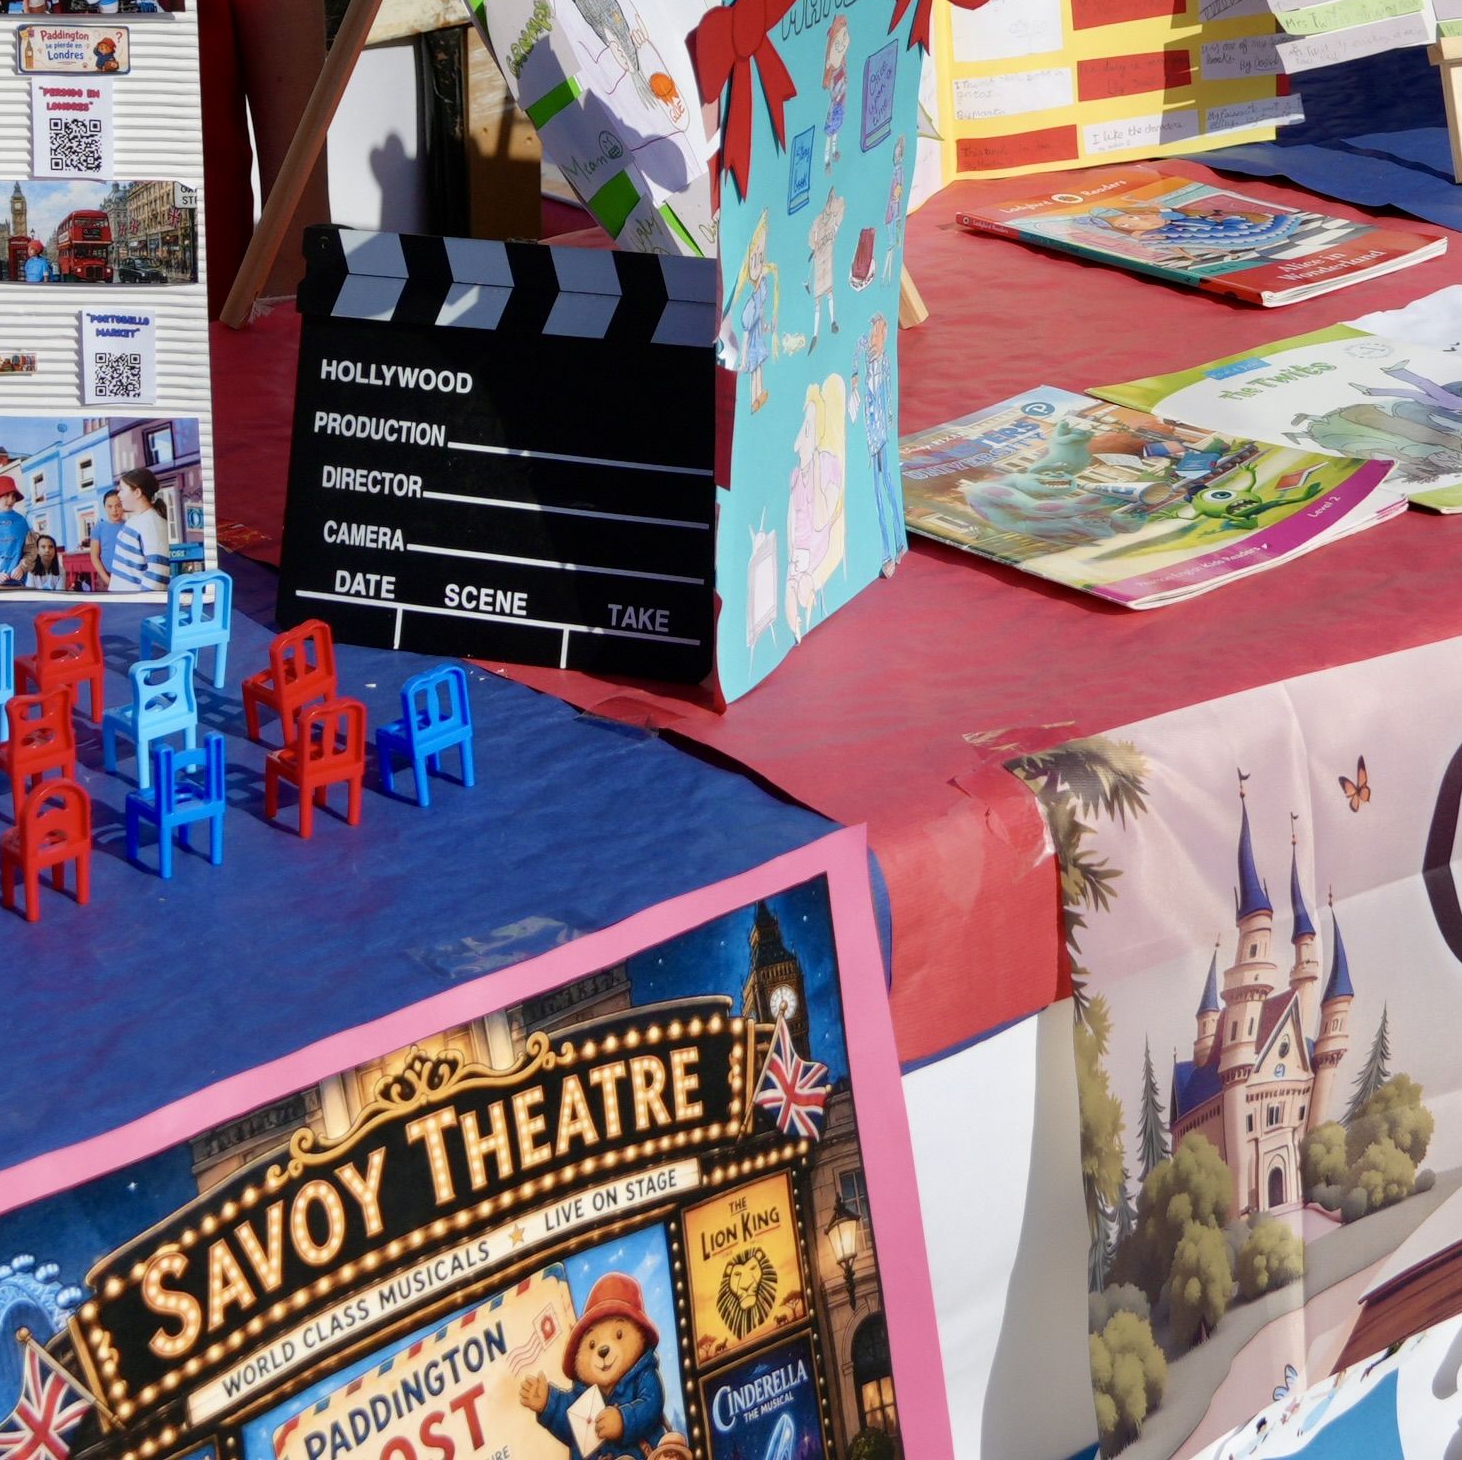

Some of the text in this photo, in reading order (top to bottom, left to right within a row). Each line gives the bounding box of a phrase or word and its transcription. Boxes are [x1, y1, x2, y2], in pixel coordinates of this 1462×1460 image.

[40, 29, 89, 43] Paddington
[53, 42, 73, 51] pierde
[47, 50, 85, 61] Londres
[1080, 178, 1127, 196] Readers
[1277, 249, 1347, 275] Alice in
[1277, 248, 1387, 283] Wonderland
[320, 357, 474, 395] HOLLYWOOD
[313, 411, 447, 448] PRODUCTION
[321, 464, 424, 500] DIRECTOR
[1306, 501, 1332, 519] Level
[322, 519, 406, 552] CAMERA
[334, 570, 671, 634] DATE SCENE TAKE
[138, 1045, 706, 1363] SAVOY THEATRE
[544, 1167, 679, 1232] LIVE ON STAGE
[728, 1196, 749, 1215] THE
[700, 1206, 782, 1259] LION KING
[221, 1240, 492, 1397] WORLD CLASS MUSICALS
[301, 1319, 510, 1460] PADDINGTON
[711, 1359, 811, 1432] CINDERELLA
[743, 1390, 795, 1422] THE MUSICAL
